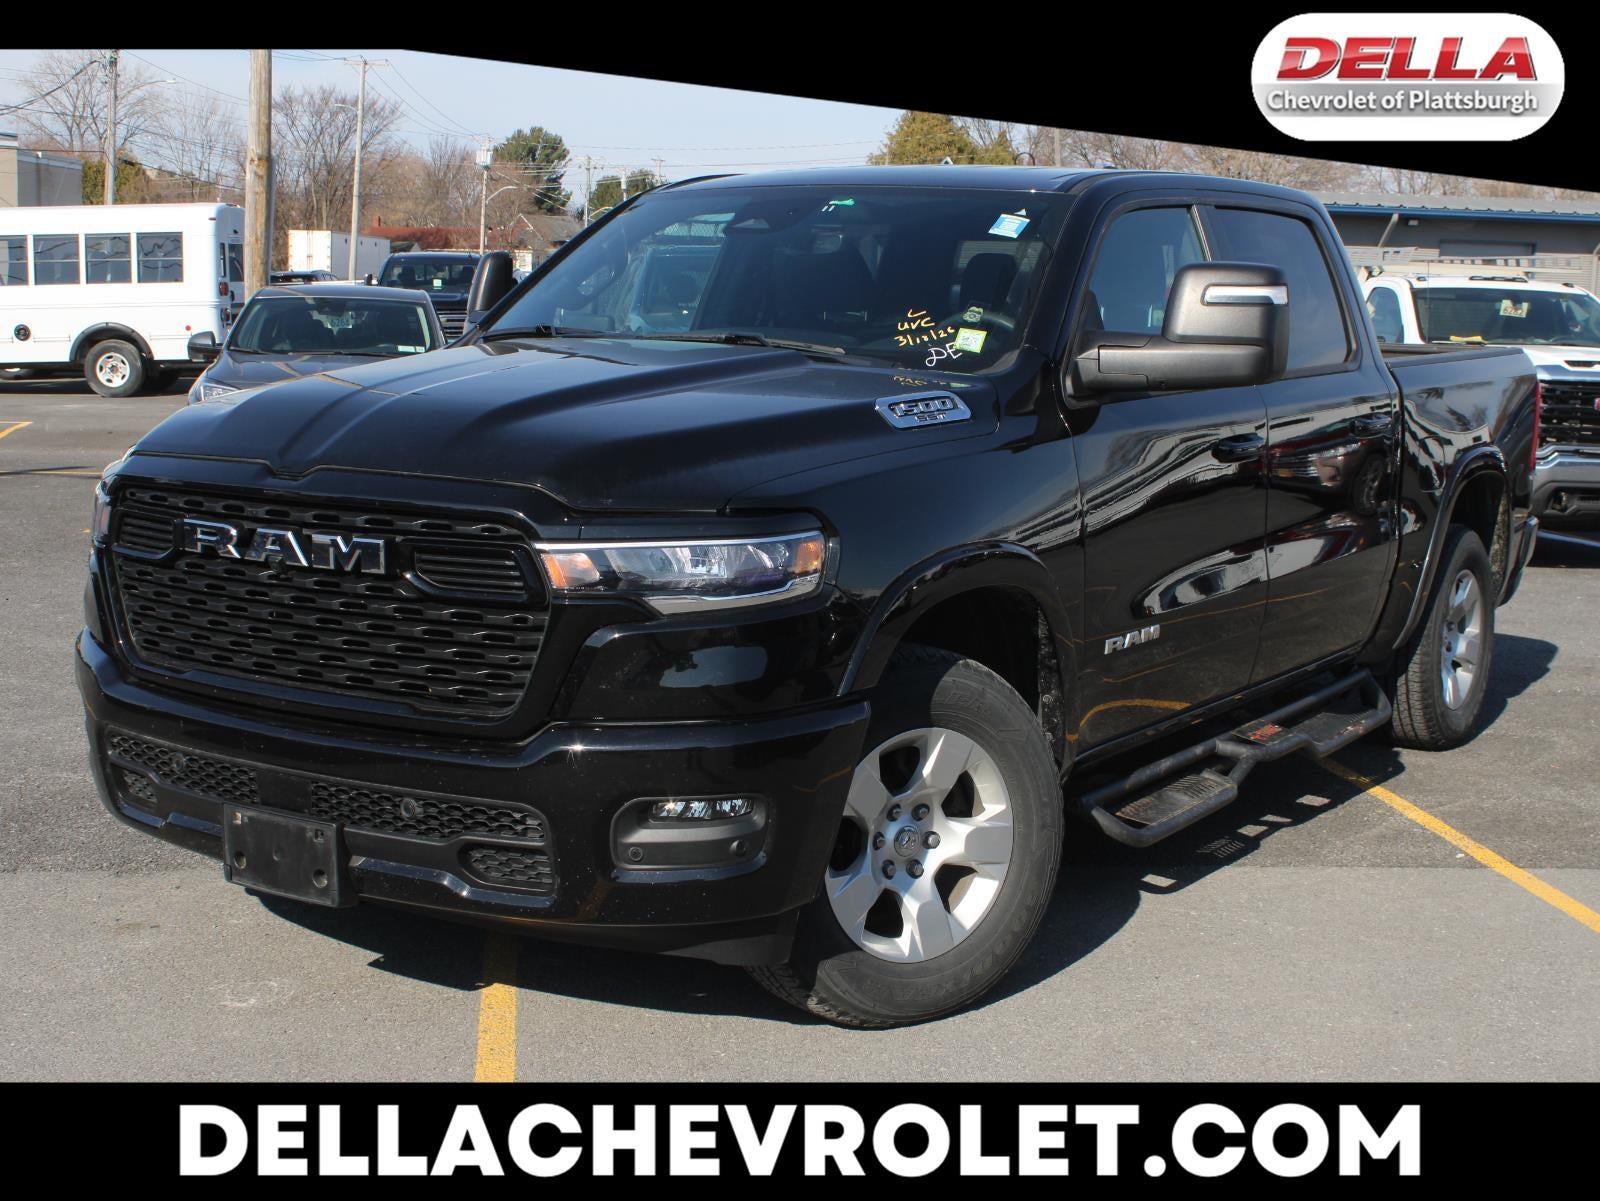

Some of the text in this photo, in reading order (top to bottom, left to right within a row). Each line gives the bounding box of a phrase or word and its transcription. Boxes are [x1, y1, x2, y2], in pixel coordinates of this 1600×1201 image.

[893, 400, 955, 418] 1500
[914, 411, 947, 423] SST
[183, 518, 385, 575] RAM
[1104, 624, 1161, 655] RAM
